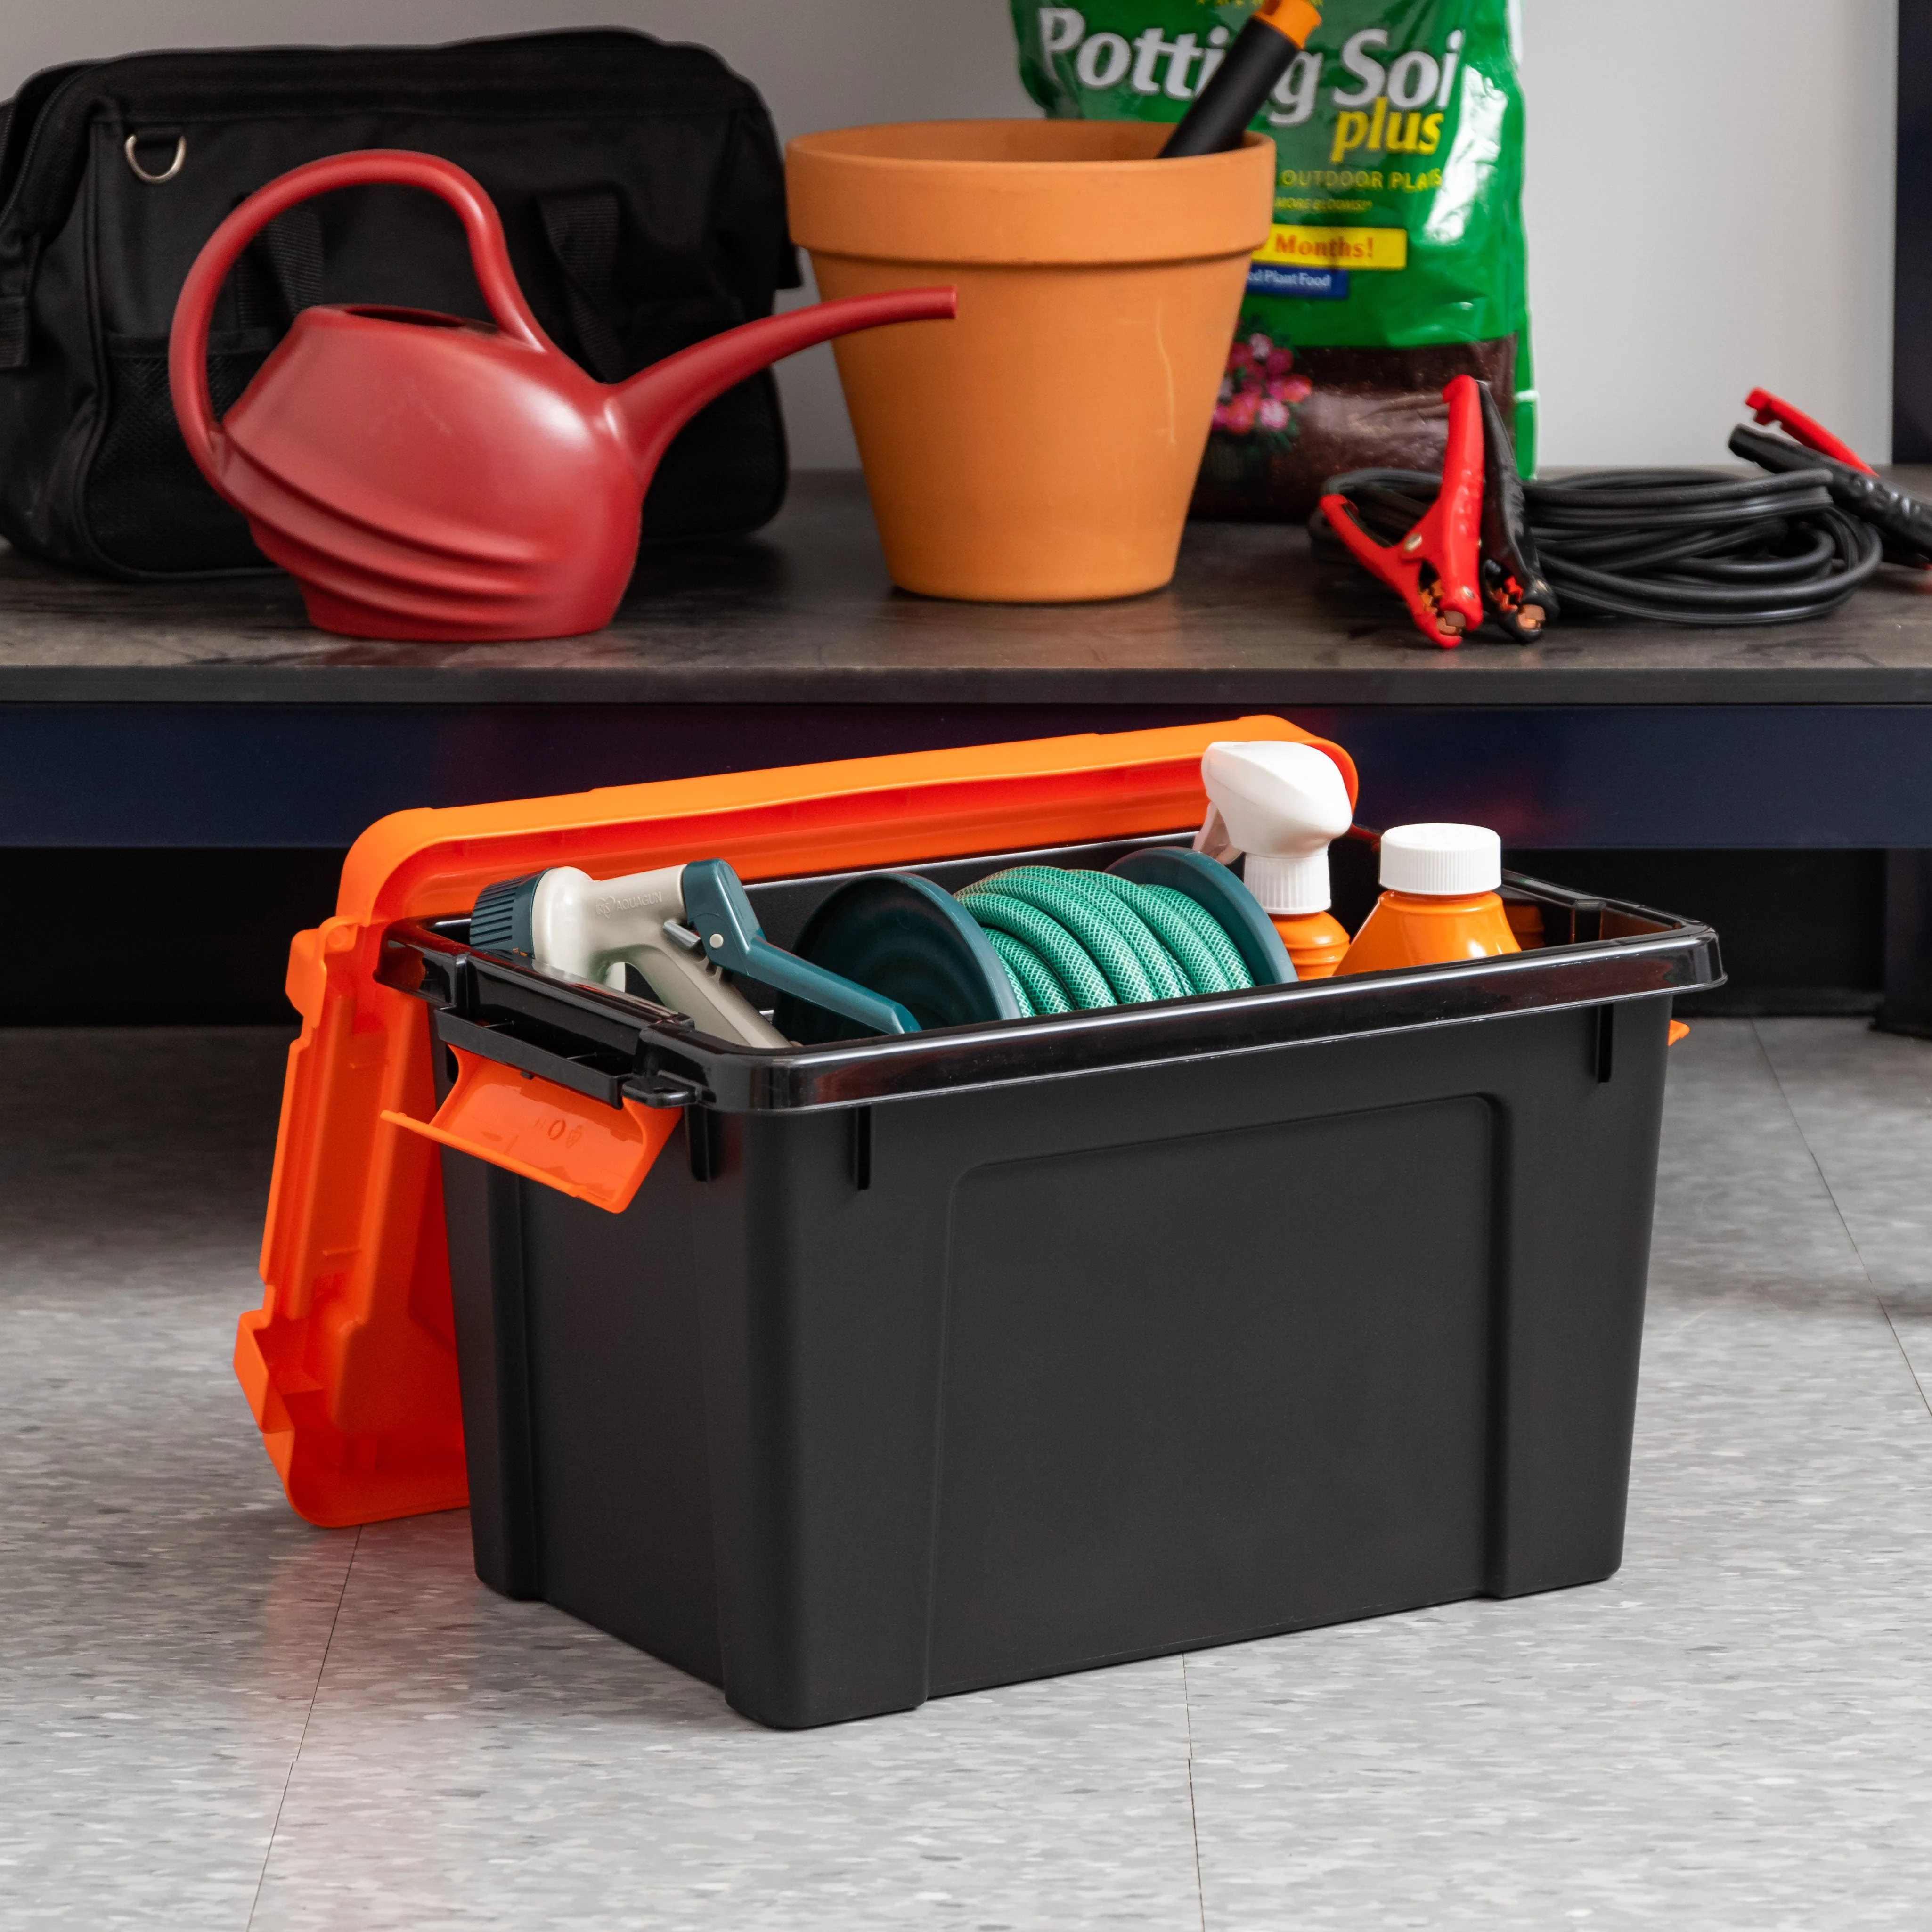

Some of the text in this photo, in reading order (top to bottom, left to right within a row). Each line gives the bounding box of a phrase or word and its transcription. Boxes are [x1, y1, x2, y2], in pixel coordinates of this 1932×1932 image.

[1037, 7, 1323, 127] Pottig
[1329, 97, 1444, 164] plus
[1280, 169, 1384, 189] OUTDOOR
[1273, 233, 1374, 258] Months!
[595, 891, 662, 915] IRIS AQUAGUN
